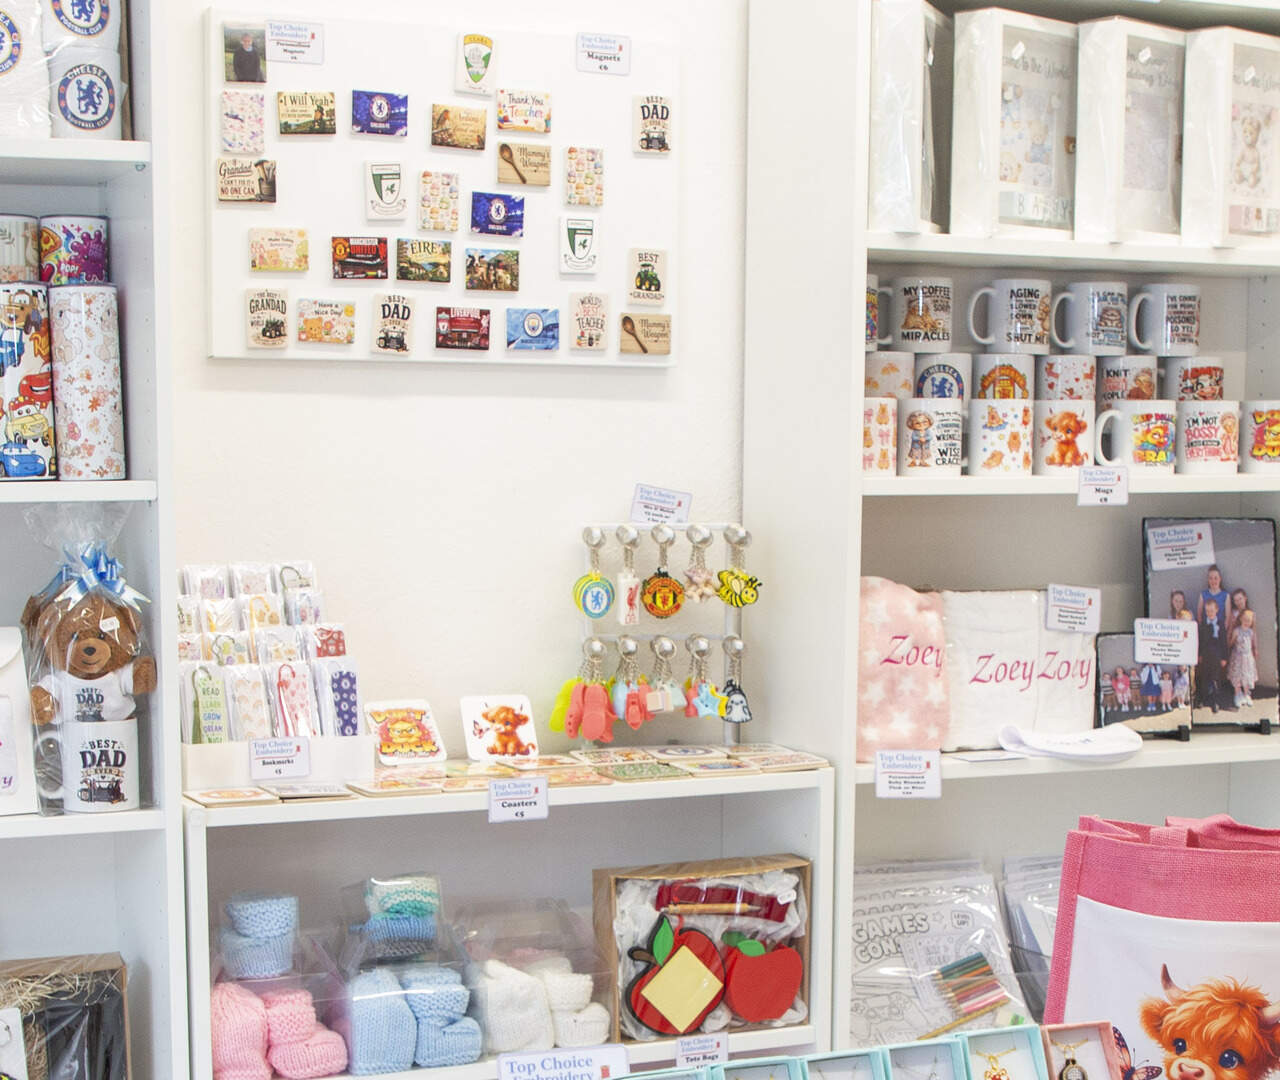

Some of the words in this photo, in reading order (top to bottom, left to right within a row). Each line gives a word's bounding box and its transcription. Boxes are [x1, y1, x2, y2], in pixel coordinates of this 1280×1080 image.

[587, 52, 621, 62] Magnets
[66, 64, 108, 83] CHELSEA
[508, 94, 529, 105] Thank
[530, 95, 544, 105] You
[641, 105, 669, 120] DAD
[638, 252, 659, 264] BEST
[903, 286, 917, 296] MY
[922, 286, 950, 297] COFFEE
[1010, 288, 1040, 299] AGING
[250, 299, 287, 315] GRANDAD
[381, 304, 411, 320] DAD
[901, 332, 950, 341] MIRACLES
[924, 364, 959, 381] CHELSEA
[1201, 417, 1218, 426] NOT
[1185, 428, 1219, 441] BOSSY
[1095, 487, 1113, 495] Mugs
[1155, 536, 1195, 546] Embroidery
[1139, 622, 1157, 632] Top
[1160, 622, 1181, 631] Choice
[1142, 630, 1181, 640] Embroidery
[880, 635, 944, 678] Zoey
[970, 653, 1037, 692] Zoey
[202, 688, 219, 696] READ
[75, 694, 104, 704] DAD
[203, 713, 221, 721] GROW
[88, 740, 118, 750] BEST
[80, 750, 127, 768] DAD
[879, 755, 897, 764] Top
[898, 754, 923, 762] Choice
[882, 762, 923, 771] Embroidery
[501, 801, 537, 809] Coasters
[851, 912, 931, 945] GAMES
[702, 1054, 719, 1063] Bags
[506, 1060, 536, 1075] Top
[540, 1056, 593, 1070] Choice
